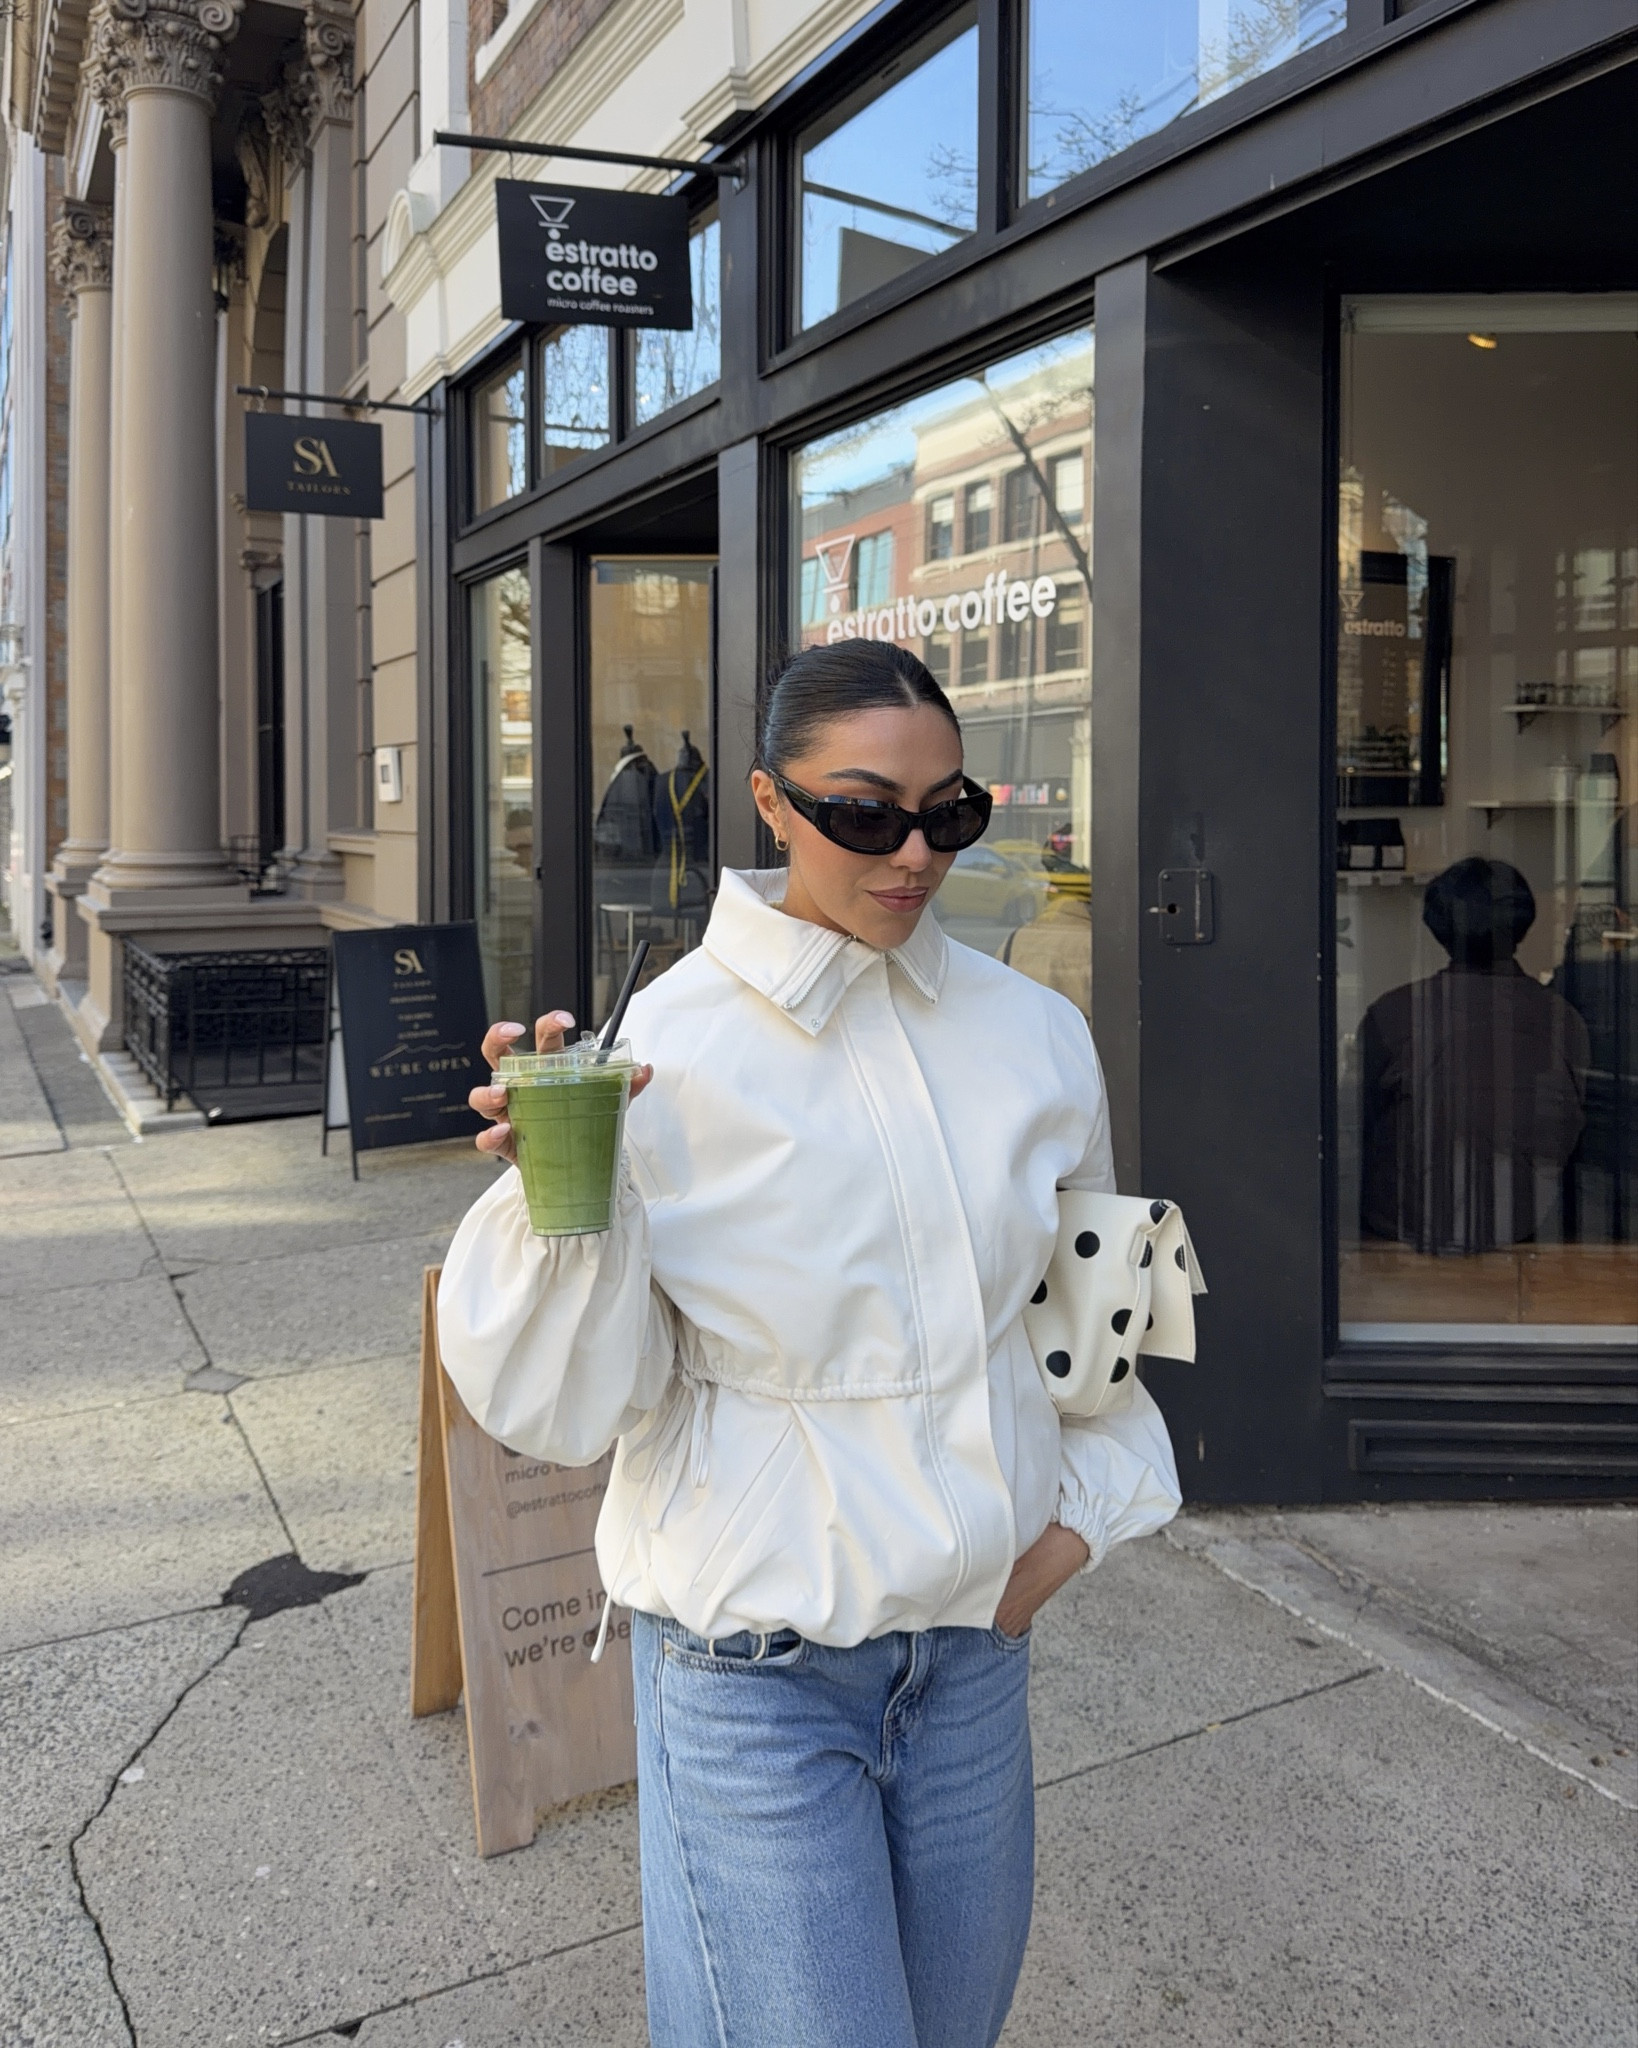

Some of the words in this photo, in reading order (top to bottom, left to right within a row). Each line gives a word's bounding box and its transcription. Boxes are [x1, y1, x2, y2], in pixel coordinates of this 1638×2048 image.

[545, 240, 658, 271] estratto
[546, 266, 638, 296] coffee
[546, 296, 578, 309] micro
[579, 298, 611, 312] coffee
[613, 303, 655, 316] roasters
[286, 480, 351, 495] TAILORS
[827, 594, 937, 644] estratto
[943, 570, 1056, 632] coffee
[1344, 618, 1406, 637] estratto
[427, 1056, 472, 1073] OPEN
[505, 1463, 550, 1483] micro
[502, 1597, 581, 1631] Come
[504, 1635, 575, 1668] we're
